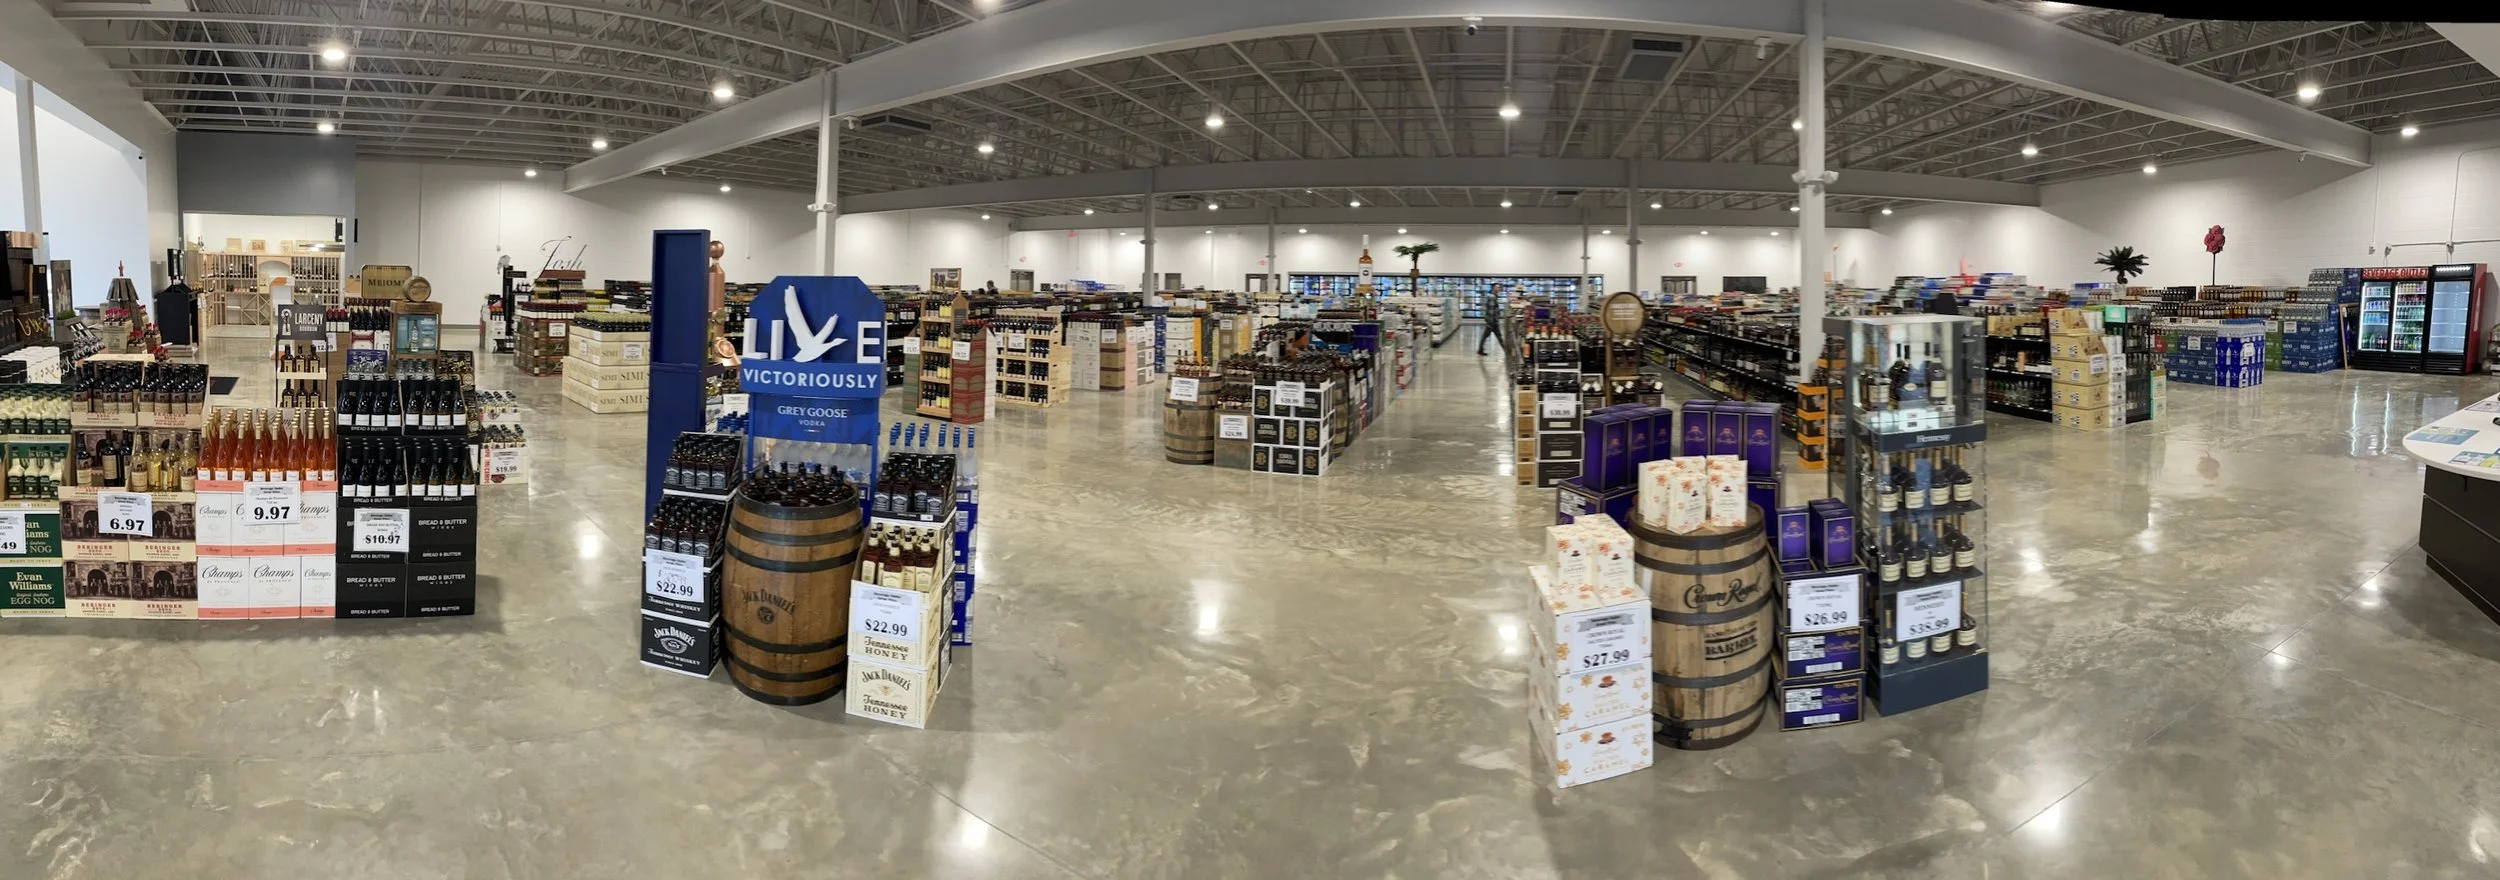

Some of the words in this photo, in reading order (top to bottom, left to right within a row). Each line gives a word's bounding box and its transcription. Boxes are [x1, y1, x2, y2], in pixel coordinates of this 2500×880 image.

[2363, 268, 2400, 278] BEVERAGE
[295, 312, 323, 325] LARCENY
[620, 372, 644, 380] SIMI
[743, 368, 878, 388] VICTORIOUSLY
[620, 395, 643, 404] SIMI
[777, 406, 807, 416] GREY
[807, 407, 848, 418] GOOSE
[200, 505, 227, 515] Champs
[254, 506, 290, 520] 9.97
[300, 501, 330, 515] hamps
[110, 518, 144, 531] 6.97
[365, 535, 400, 544] $10.97
[16, 572, 42, 580] Evan
[202, 564, 243, 580] Champs
[253, 564, 294, 579] Champs
[304, 568, 331, 578] Champs
[9, 582, 52, 590] Williams
[656, 581, 693, 596] $22.99
[1684, 584, 1727, 609] Crown
[675, 602, 701, 612] WHISKEY
[1804, 611, 1848, 626] $26.99
[654, 627, 670, 638] JACK
[865, 618, 907, 636] $22.99
[864, 636, 909, 653] Tennessee
[1706, 634, 1757, 655] BARREL
[675, 655, 700, 665] WHISKEY
[865, 646, 908, 661] HONEY
[1583, 649, 1630, 668] $27.99
[862, 671, 880, 682] JACK
[881, 669, 912, 691] DANIEL'S
[863, 694, 908, 711] Tennessee
[864, 705, 906, 719] HONEY
